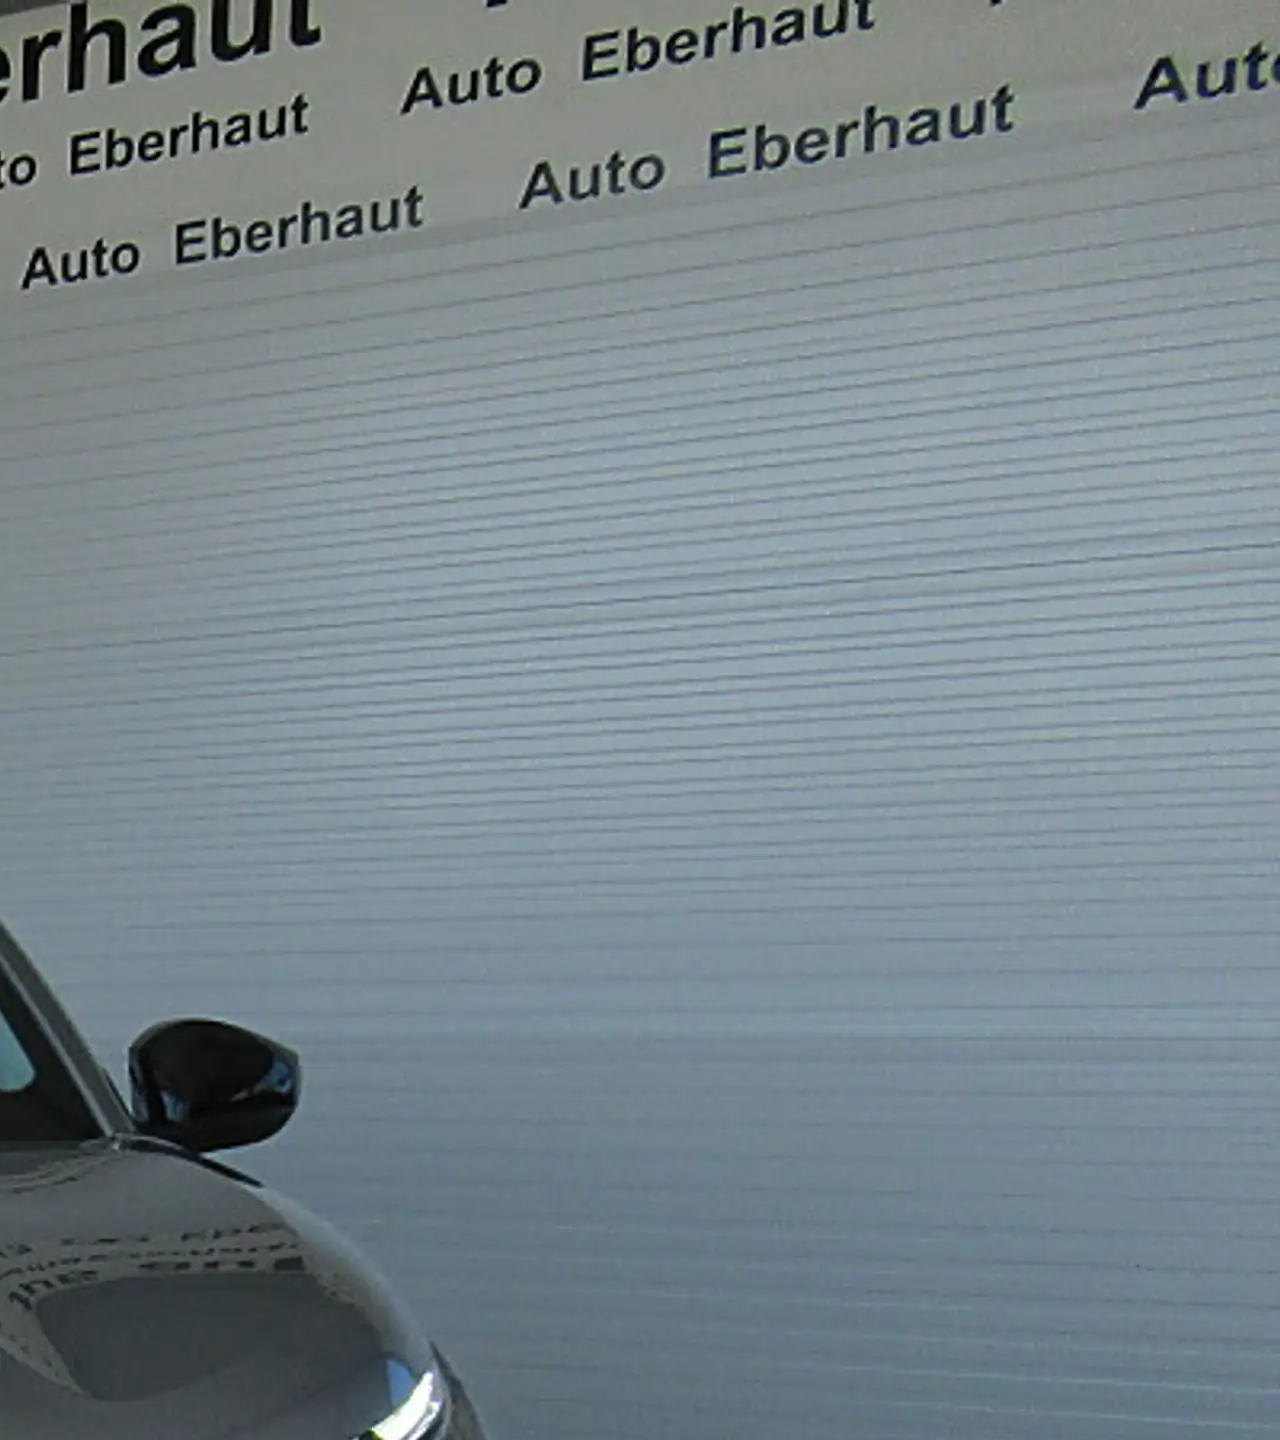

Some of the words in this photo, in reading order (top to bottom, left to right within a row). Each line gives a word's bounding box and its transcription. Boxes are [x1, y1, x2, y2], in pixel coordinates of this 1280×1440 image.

[402, 56, 541, 114] Auto
[582, 0, 874, 80] Eberhaut
[68, 92, 309, 176] Eberhaut
[520, 151, 666, 210] Auto
[708, 84, 1015, 179] Eberhaut
[22, 239, 140, 290] Auto
[176, 184, 424, 266] Eberhaut
